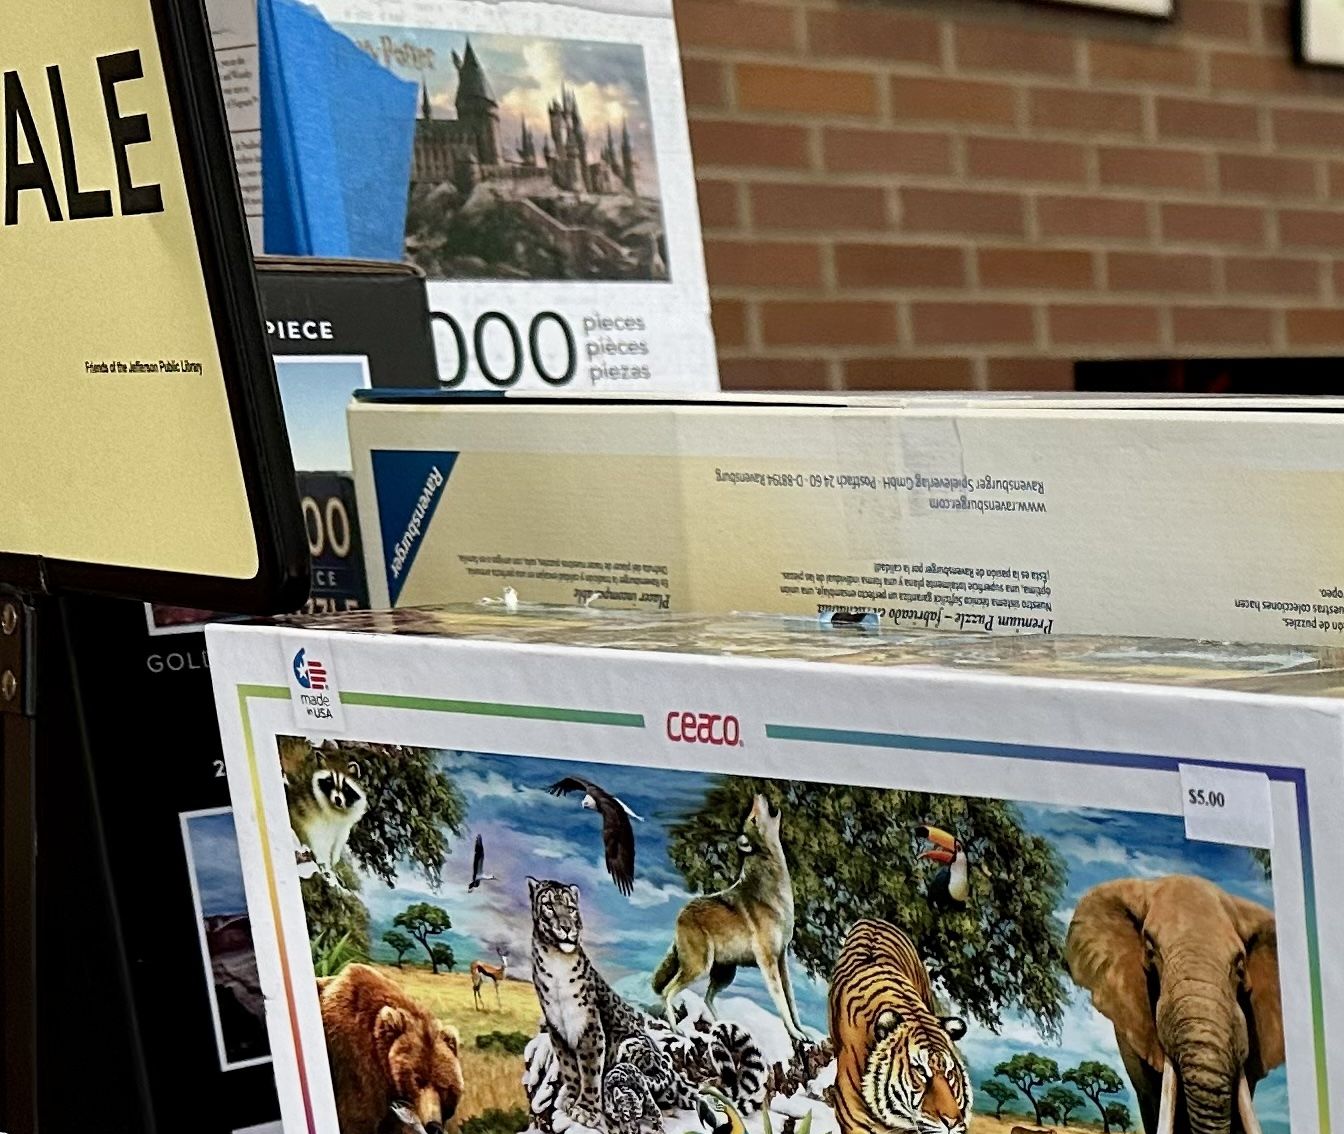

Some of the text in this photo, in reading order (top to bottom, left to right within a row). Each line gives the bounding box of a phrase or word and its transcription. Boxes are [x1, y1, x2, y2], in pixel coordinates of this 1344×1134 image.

[3, 49, 164, 226] ALE
[583, 312, 646, 335] pieces
[585, 337, 650, 358] pièces
[110, 361, 116, 373] of
[116, 361, 127, 373] the
[159, 360, 180, 373] Public
[589, 362, 652, 385] piezas
[838, 474, 876, 489] Postfach
[883, 476, 914, 490] GmbH
[977, 475, 1045, 495] Ravensburger
[929, 497, 1047, 514] www.ravensburger.com
[391, 466, 444, 580] Ravensburger
[1235, 599, 1260, 612] hacen
[1262, 601, 1311, 614] colecciones
[889, 607, 945, 629] fabricado
[954, 613, 994, 631] Puzzle
[998, 615, 1054, 635] Premium
[1282, 617, 1317, 630] puzzles.
[1319, 621, 1330, 632] de
[300, 692, 331, 708] made
[313, 706, 334, 720] USA
[1188, 788, 1226, 808] $5.00
